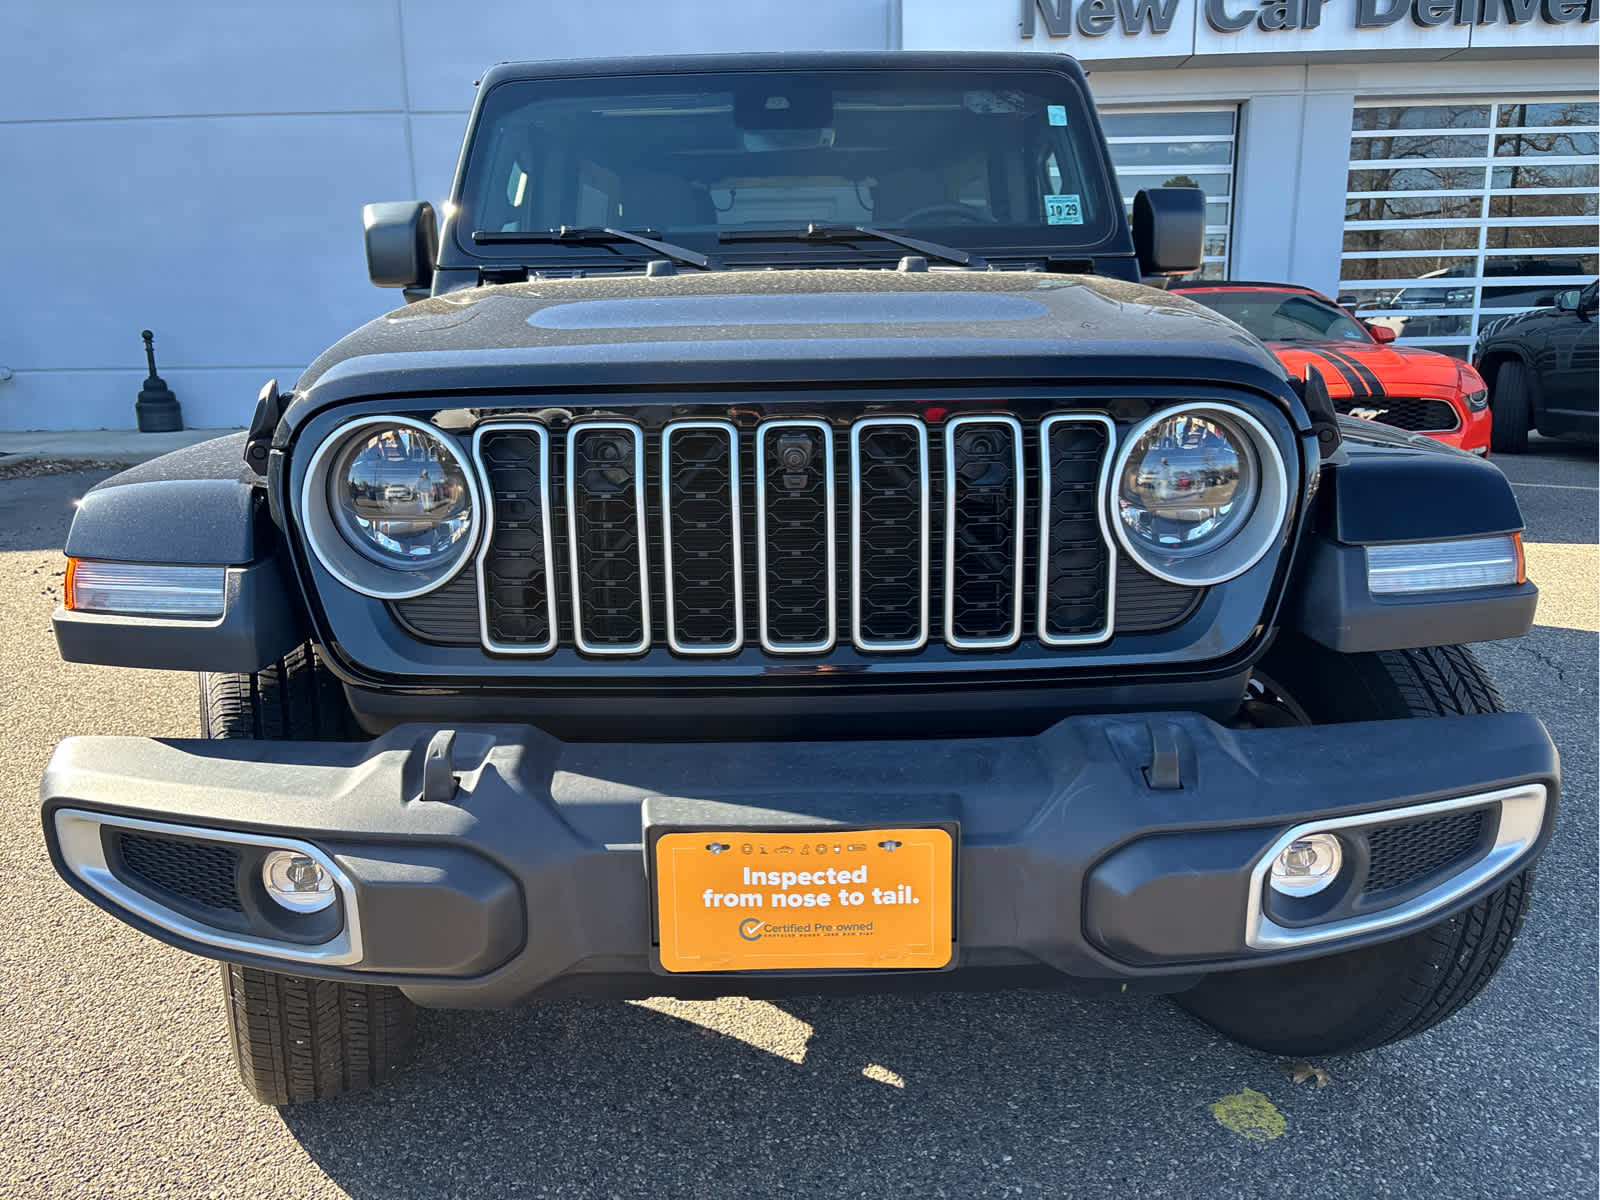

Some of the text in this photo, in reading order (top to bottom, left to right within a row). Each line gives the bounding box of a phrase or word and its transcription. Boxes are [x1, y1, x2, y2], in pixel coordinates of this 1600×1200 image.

[1020, 0, 1599, 38] New Car Delive
[1065, 204, 1077, 216] 29
[743, 865, 868, 890] Inspected
[702, 884, 919, 908] from nose to tail.
[764, 923, 811, 933] Certified
